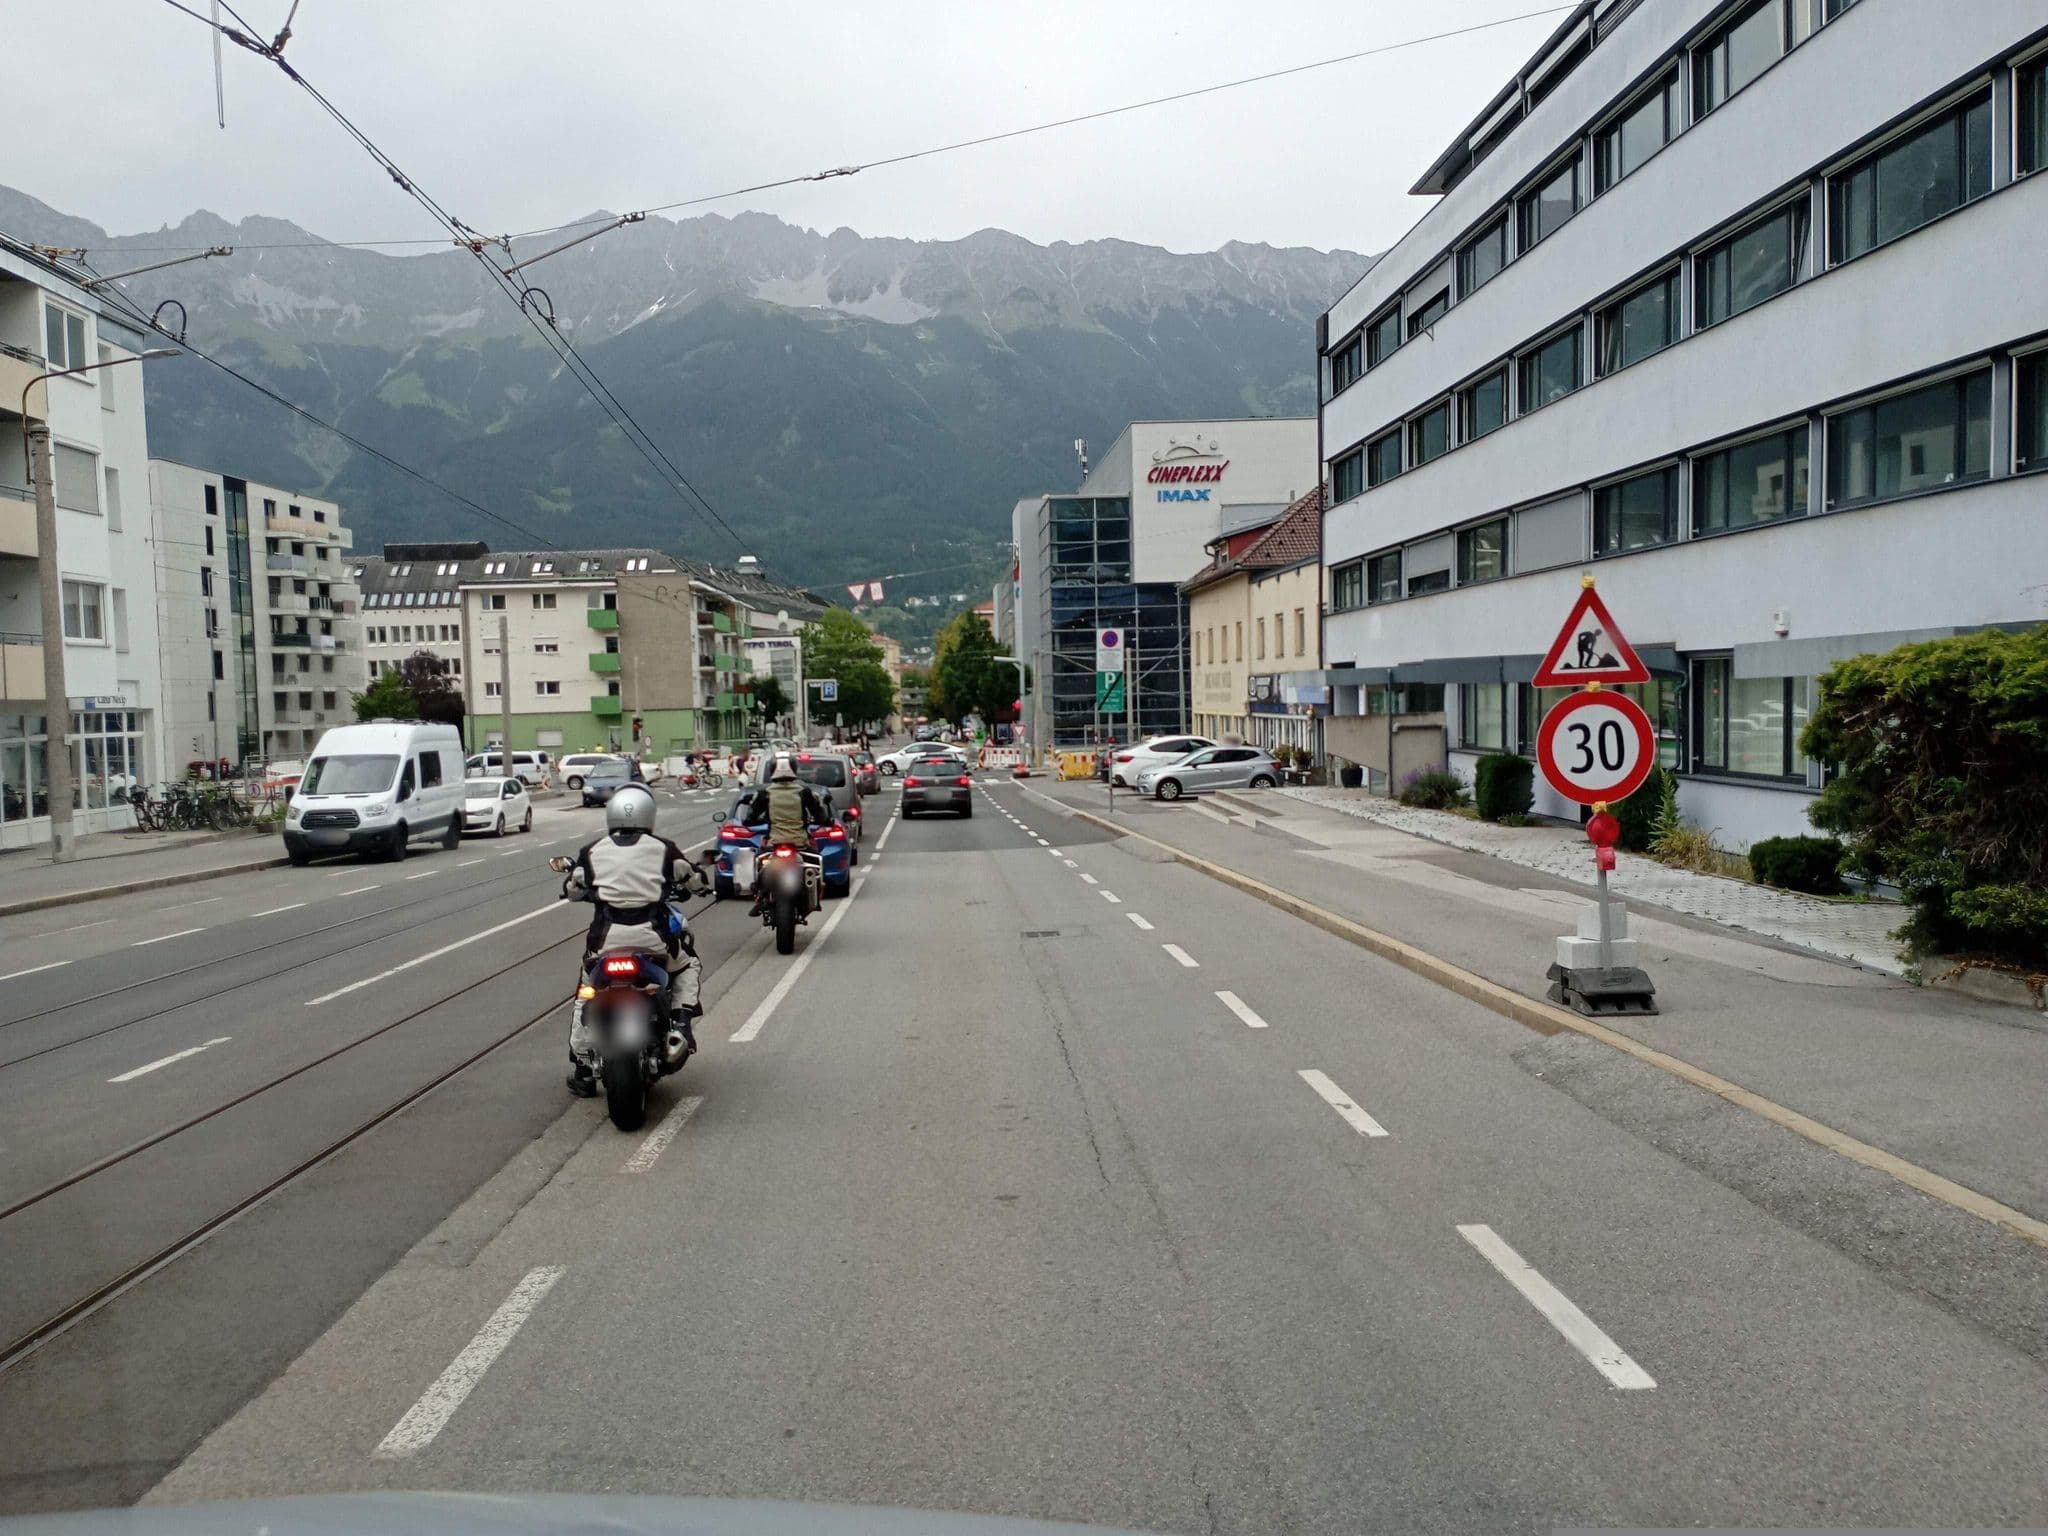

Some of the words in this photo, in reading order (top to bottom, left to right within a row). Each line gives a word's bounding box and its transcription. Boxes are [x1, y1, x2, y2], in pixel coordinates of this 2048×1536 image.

[1147, 460, 1230, 484] CINEPLEXX
[1157, 488, 1211, 502] IMAX
[1104, 672, 1117, 690] P
[1567, 719, 1625, 774] 30
